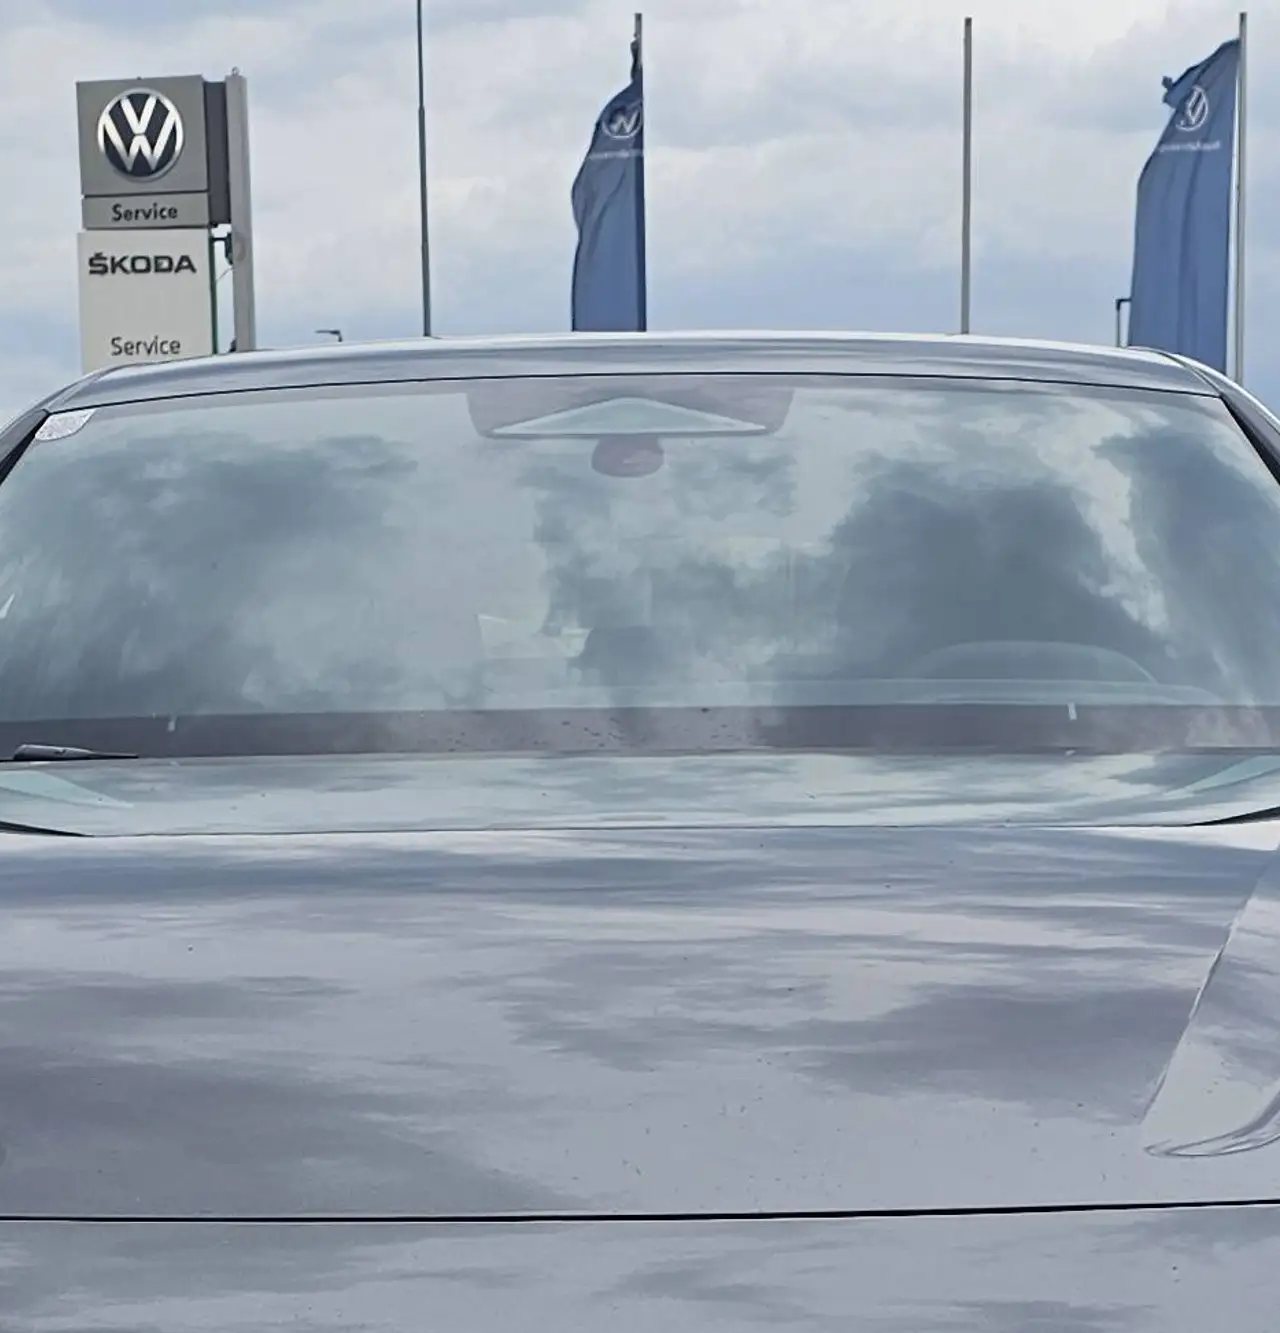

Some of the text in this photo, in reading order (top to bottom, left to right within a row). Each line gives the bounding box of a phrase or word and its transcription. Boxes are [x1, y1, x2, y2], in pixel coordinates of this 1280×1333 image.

[112, 202, 178, 222] Service
[88, 252, 197, 275] ŠKODA
[111, 335, 181, 356] Service
